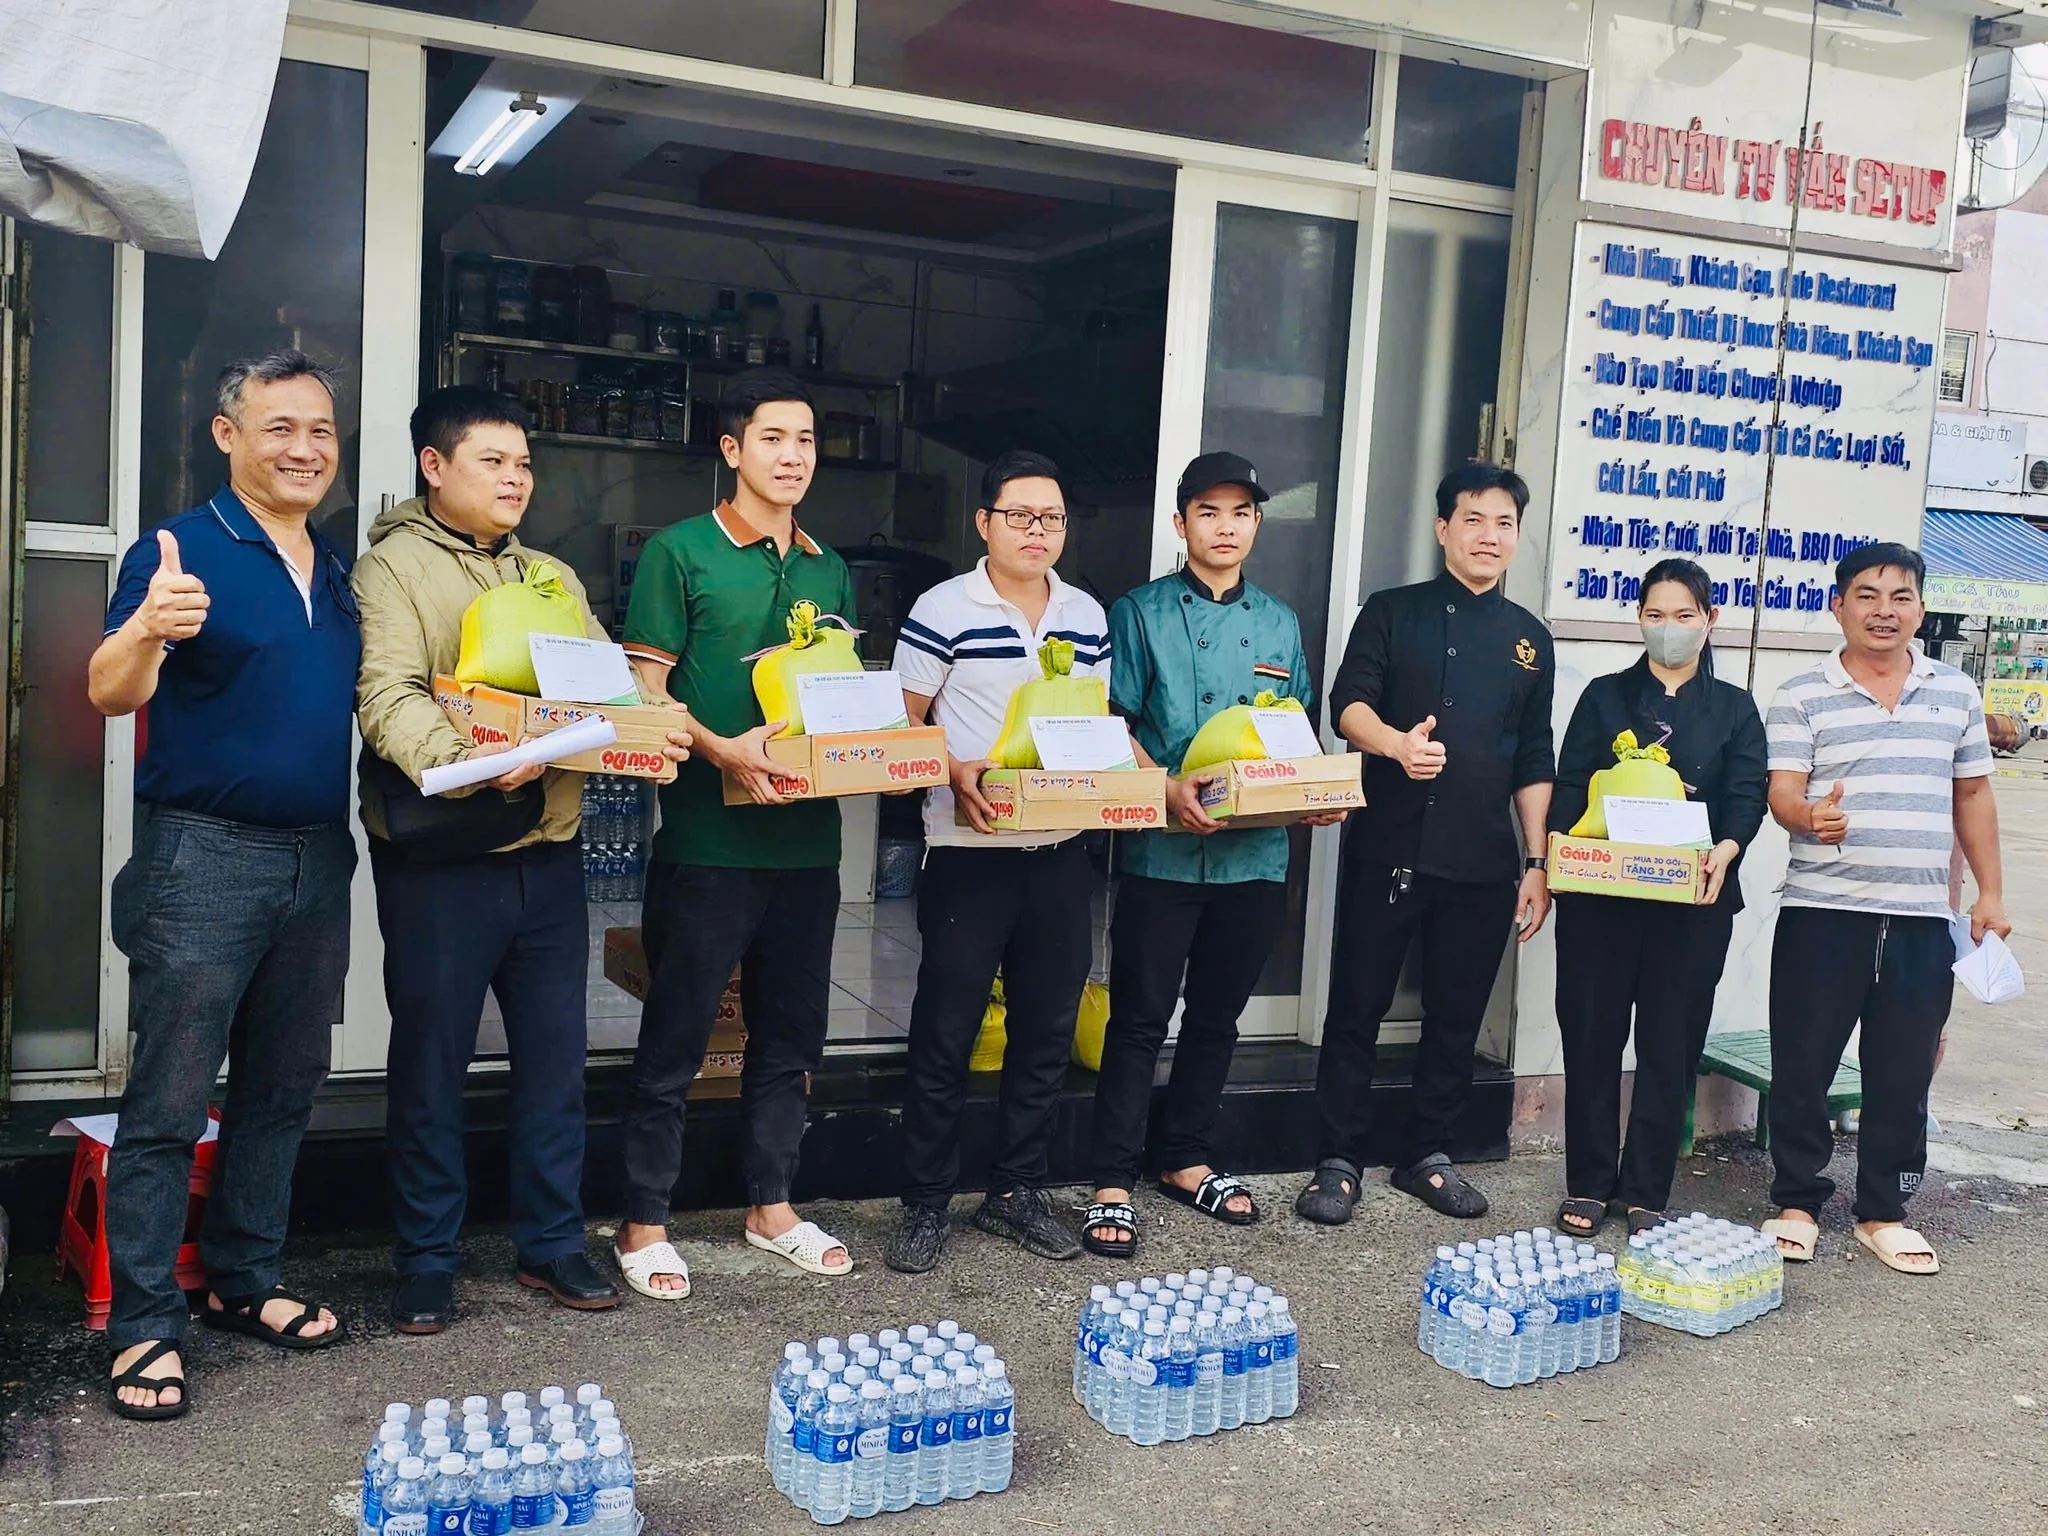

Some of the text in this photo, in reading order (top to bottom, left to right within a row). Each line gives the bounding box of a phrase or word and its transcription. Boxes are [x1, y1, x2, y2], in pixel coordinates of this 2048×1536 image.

[1601, 116, 1729, 195] CHUYÊN
[1852, 158, 1947, 225] SETUP
[1603, 243, 1637, 277] Nhà
[1688, 254, 1739, 290] Khách
[1815, 272, 1897, 311] Restaurant
[1599, 298, 1641, 336] Cung
[1643, 299, 1675, 340] Cấp
[1678, 305, 1718, 342] Thiết
[1718, 313, 1738, 352] Bị
[1739, 316, 1775, 348] Inox
[1855, 330, 1902, 363] Khách
[1905, 336, 1934, 373] Sạn
[1629, 356, 1659, 395] Tạo
[1696, 360, 1727, 399] Bếp
[1789, 375, 1842, 413] Nghiệp
[1591, 404, 1624, 440] Chế
[1624, 407, 1661, 444] Biến
[1664, 414, 1686, 446] Và
[1689, 416, 1728, 452] Cung
[1731, 416, 1761, 455] Cấp
[1790, 425, 1811, 458] Cả
[1813, 428, 1842, 460] Các
[1845, 432, 1877, 469] Loại
[1951, 424, 1961, 437] &
[1965, 425, 1995, 441] GIẶT
[1597, 458, 1625, 494] Cốt
[1665, 464, 1692, 498] Cốt
[1694, 468, 1726, 501] Phở
[1580, 516, 1623, 554] Nhận
[1627, 518, 1660, 556] Tiệc
[1736, 527, 1760, 562] Tại
[1800, 532, 1831, 565] BBQ
[1577, 568, 1607, 600] Đào
[1611, 571, 1640, 607] Tạo
[1764, 575, 1792, 609] Cầu
[1796, 577, 1824, 611] Của
[1626, 863, 1655, 876] TẶNG
[1658, 867, 1664, 876] 3
